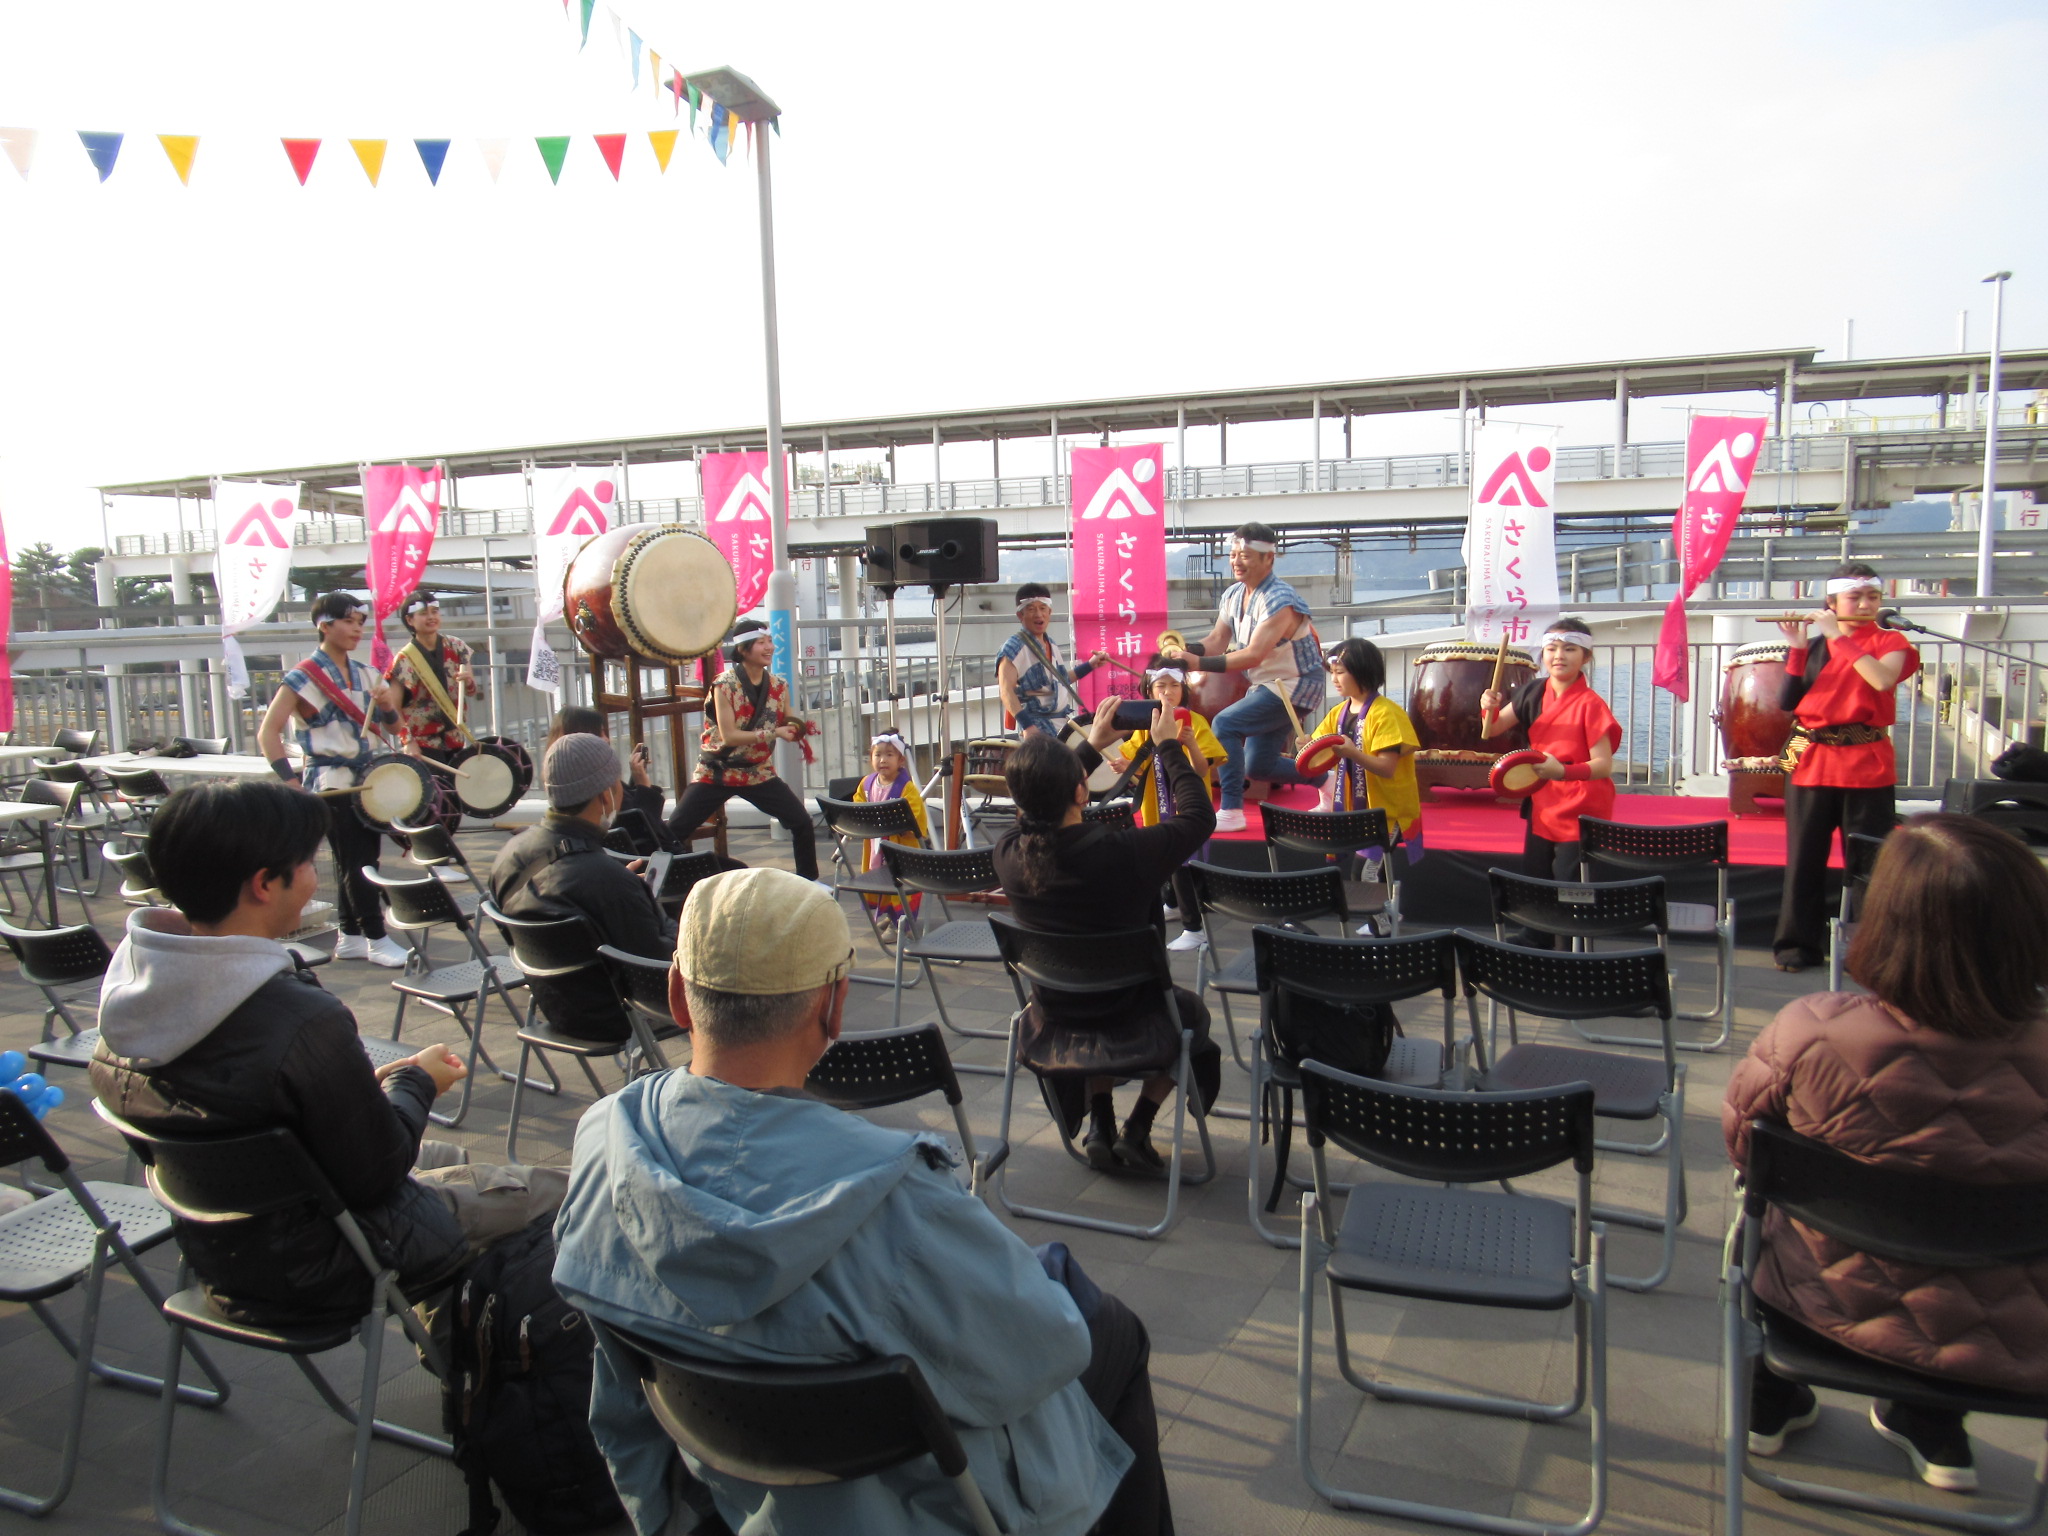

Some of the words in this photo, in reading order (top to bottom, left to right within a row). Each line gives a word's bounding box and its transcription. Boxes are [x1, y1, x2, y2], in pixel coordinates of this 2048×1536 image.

[1096, 533, 1106, 594] SAKURAJIMA
[1484, 517, 1493, 581] SAKURAJIMA
[1098, 598, 1106, 622] Local
[1115, 531, 1143, 658] さくら市
[1484, 584, 1494, 605] Local
[1501, 518, 1532, 643] さくら市
